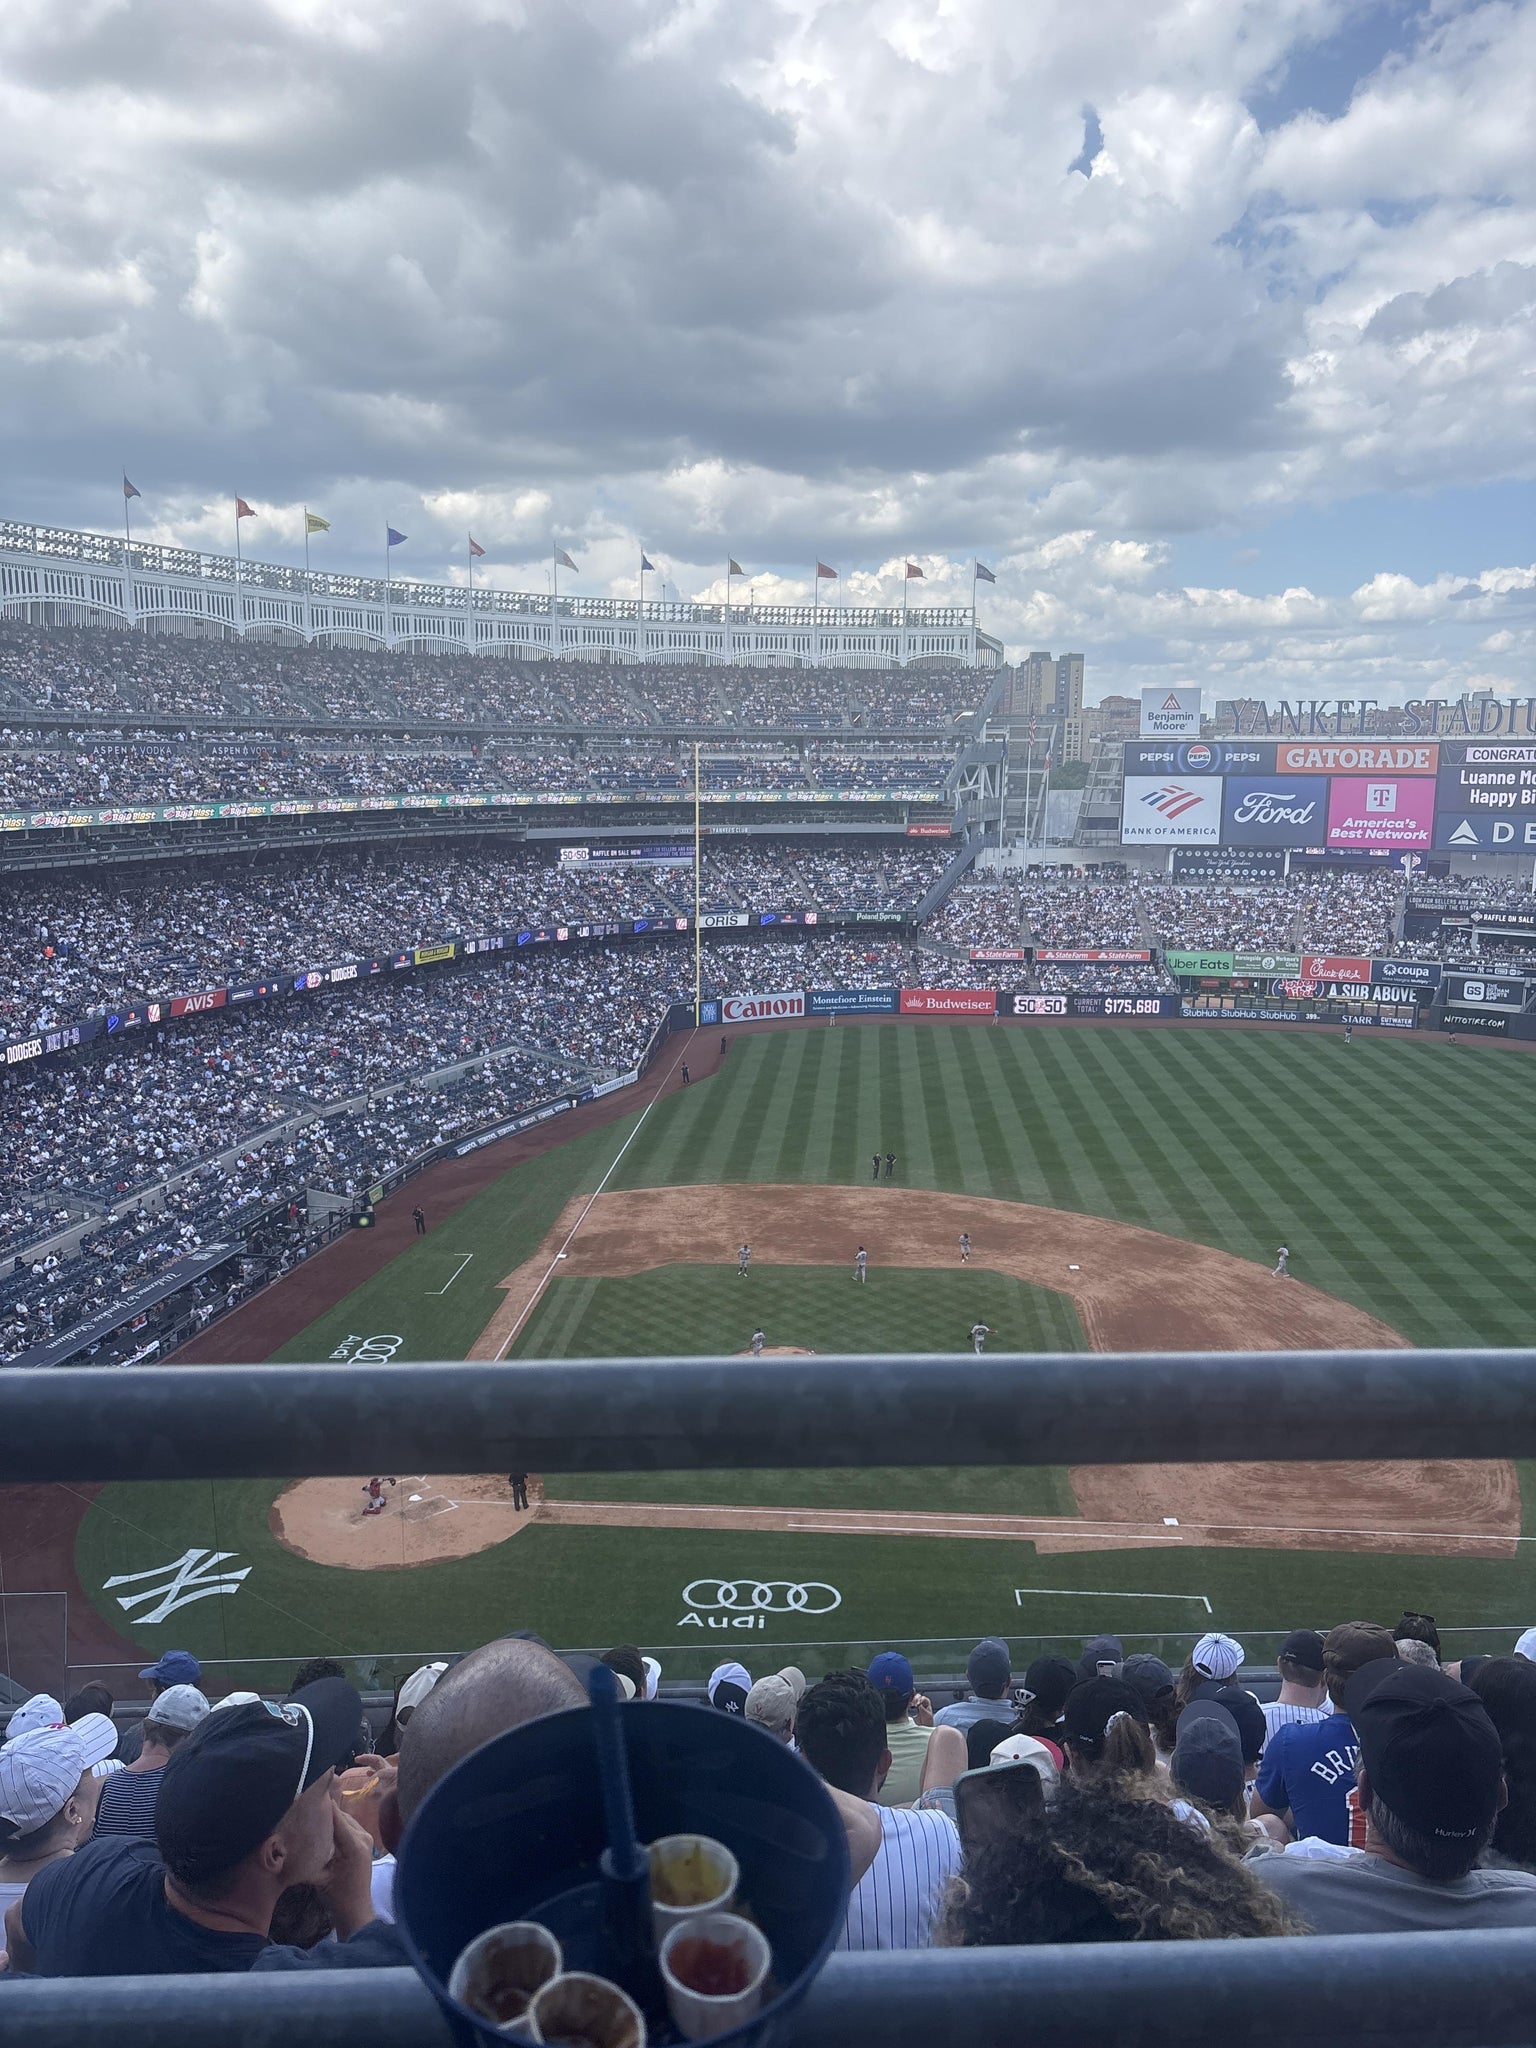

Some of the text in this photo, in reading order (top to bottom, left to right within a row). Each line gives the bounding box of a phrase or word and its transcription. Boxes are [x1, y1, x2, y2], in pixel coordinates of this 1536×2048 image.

[1148, 712, 1194, 722] Benjamin
[1230, 700, 1378, 733] YANKEE
[1154, 722, 1186, 730] Moore
[93, 746, 126, 754] ASPEN
[140, 746, 172, 755] VODKA
[212, 746, 240, 754] ASPEN
[1473, 750, 1536, 760] CONGRAT
[1140, 753, 1174, 762] PEPSI
[1226, 753, 1260, 762] PEPSI
[1286, 748, 1430, 768] GATORADE
[1460, 770, 1516, 784] Luanne
[1470, 789, 1517, 808] Happy
[175, 808, 214, 818] Baja Blast
[1234, 792, 1316, 824] Ford
[4, 818, 26, 827] Blast
[45, 815, 66, 826] Baja
[68, 815, 93, 824] Blast
[112, 811, 156, 822] Baja Blast
[1343, 818, 1416, 829] America's
[1330, 828, 1428, 840] Best Network
[706, 916, 738, 926] ORIS
[856, 912, 901, 922] Poland Spring
[1169, 958, 1198, 968] Uber
[1200, 960, 1230, 970] Eats
[1310, 960, 1360, 979] Chick-fil-A
[331, 965, 358, 982] DODGERS
[1398, 966, 1429, 978] coupa
[1330, 984, 1417, 1002] A SUB ABOVE
[1467, 986, 1482, 996] GS
[184, 994, 214, 1012] AVIS
[813, 994, 892, 1004] Montefiore Einstein
[926, 998, 990, 1010] Budweiser
[724, 997, 802, 1019] Canon
[1018, 1000, 1062, 1012] 50 50
[1104, 998, 1160, 1014] $175,680
[1183, 1009, 1296, 1020] StubHub StubHub StubHub
[1342, 1014, 1372, 1024] STARR
[6, 1039, 42, 1064] DODGERS
[329, 1334, 362, 1358] Audi
[676, 1612, 764, 1629] Audi
[1435, 1828, 1466, 1838] Hurley
